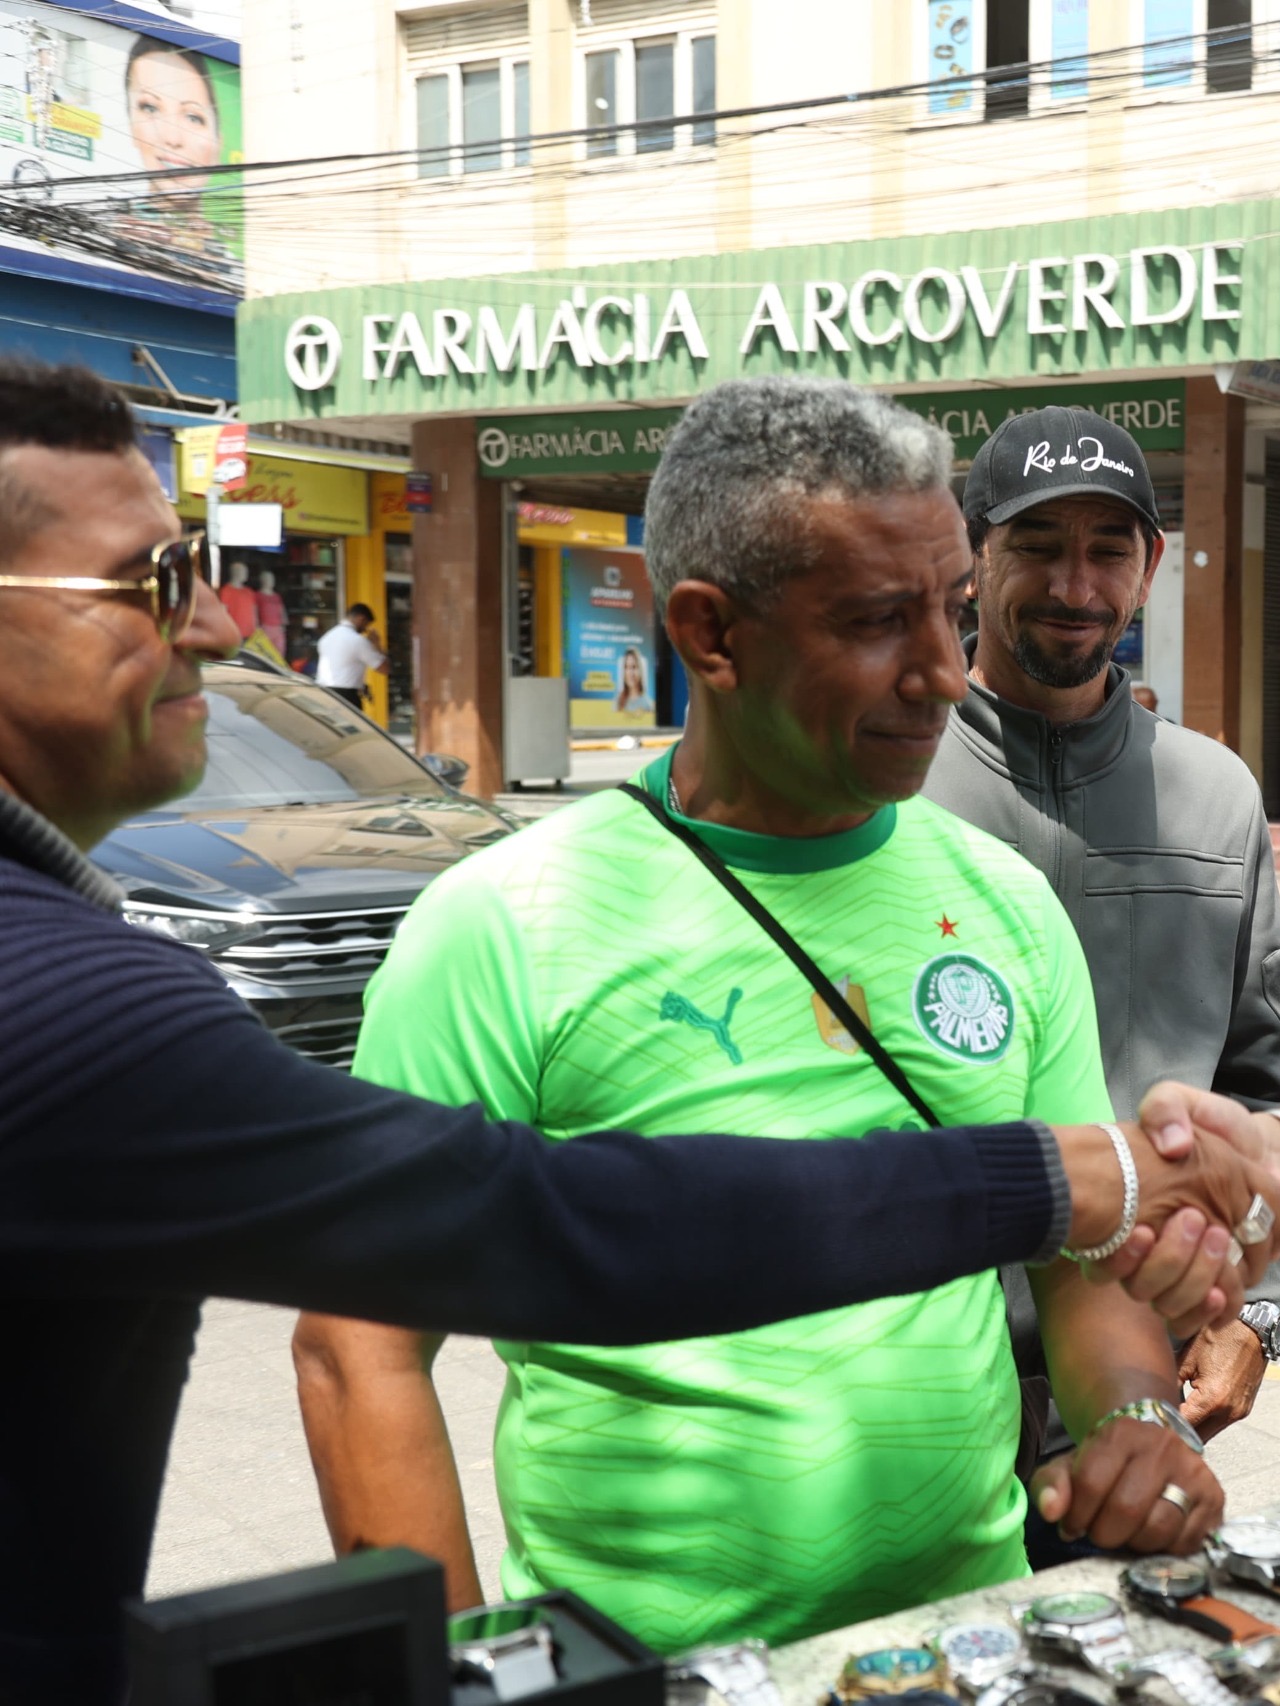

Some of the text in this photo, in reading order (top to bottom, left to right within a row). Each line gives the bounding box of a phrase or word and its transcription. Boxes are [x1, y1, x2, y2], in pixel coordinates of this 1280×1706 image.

[363, 287, 708, 381] FARMÁCIA
[740, 243, 1244, 354] ARCOVERDE
[508, 427, 625, 459] FARMÁCIA
[1023, 436, 1135, 478] Rio de Janeiro
